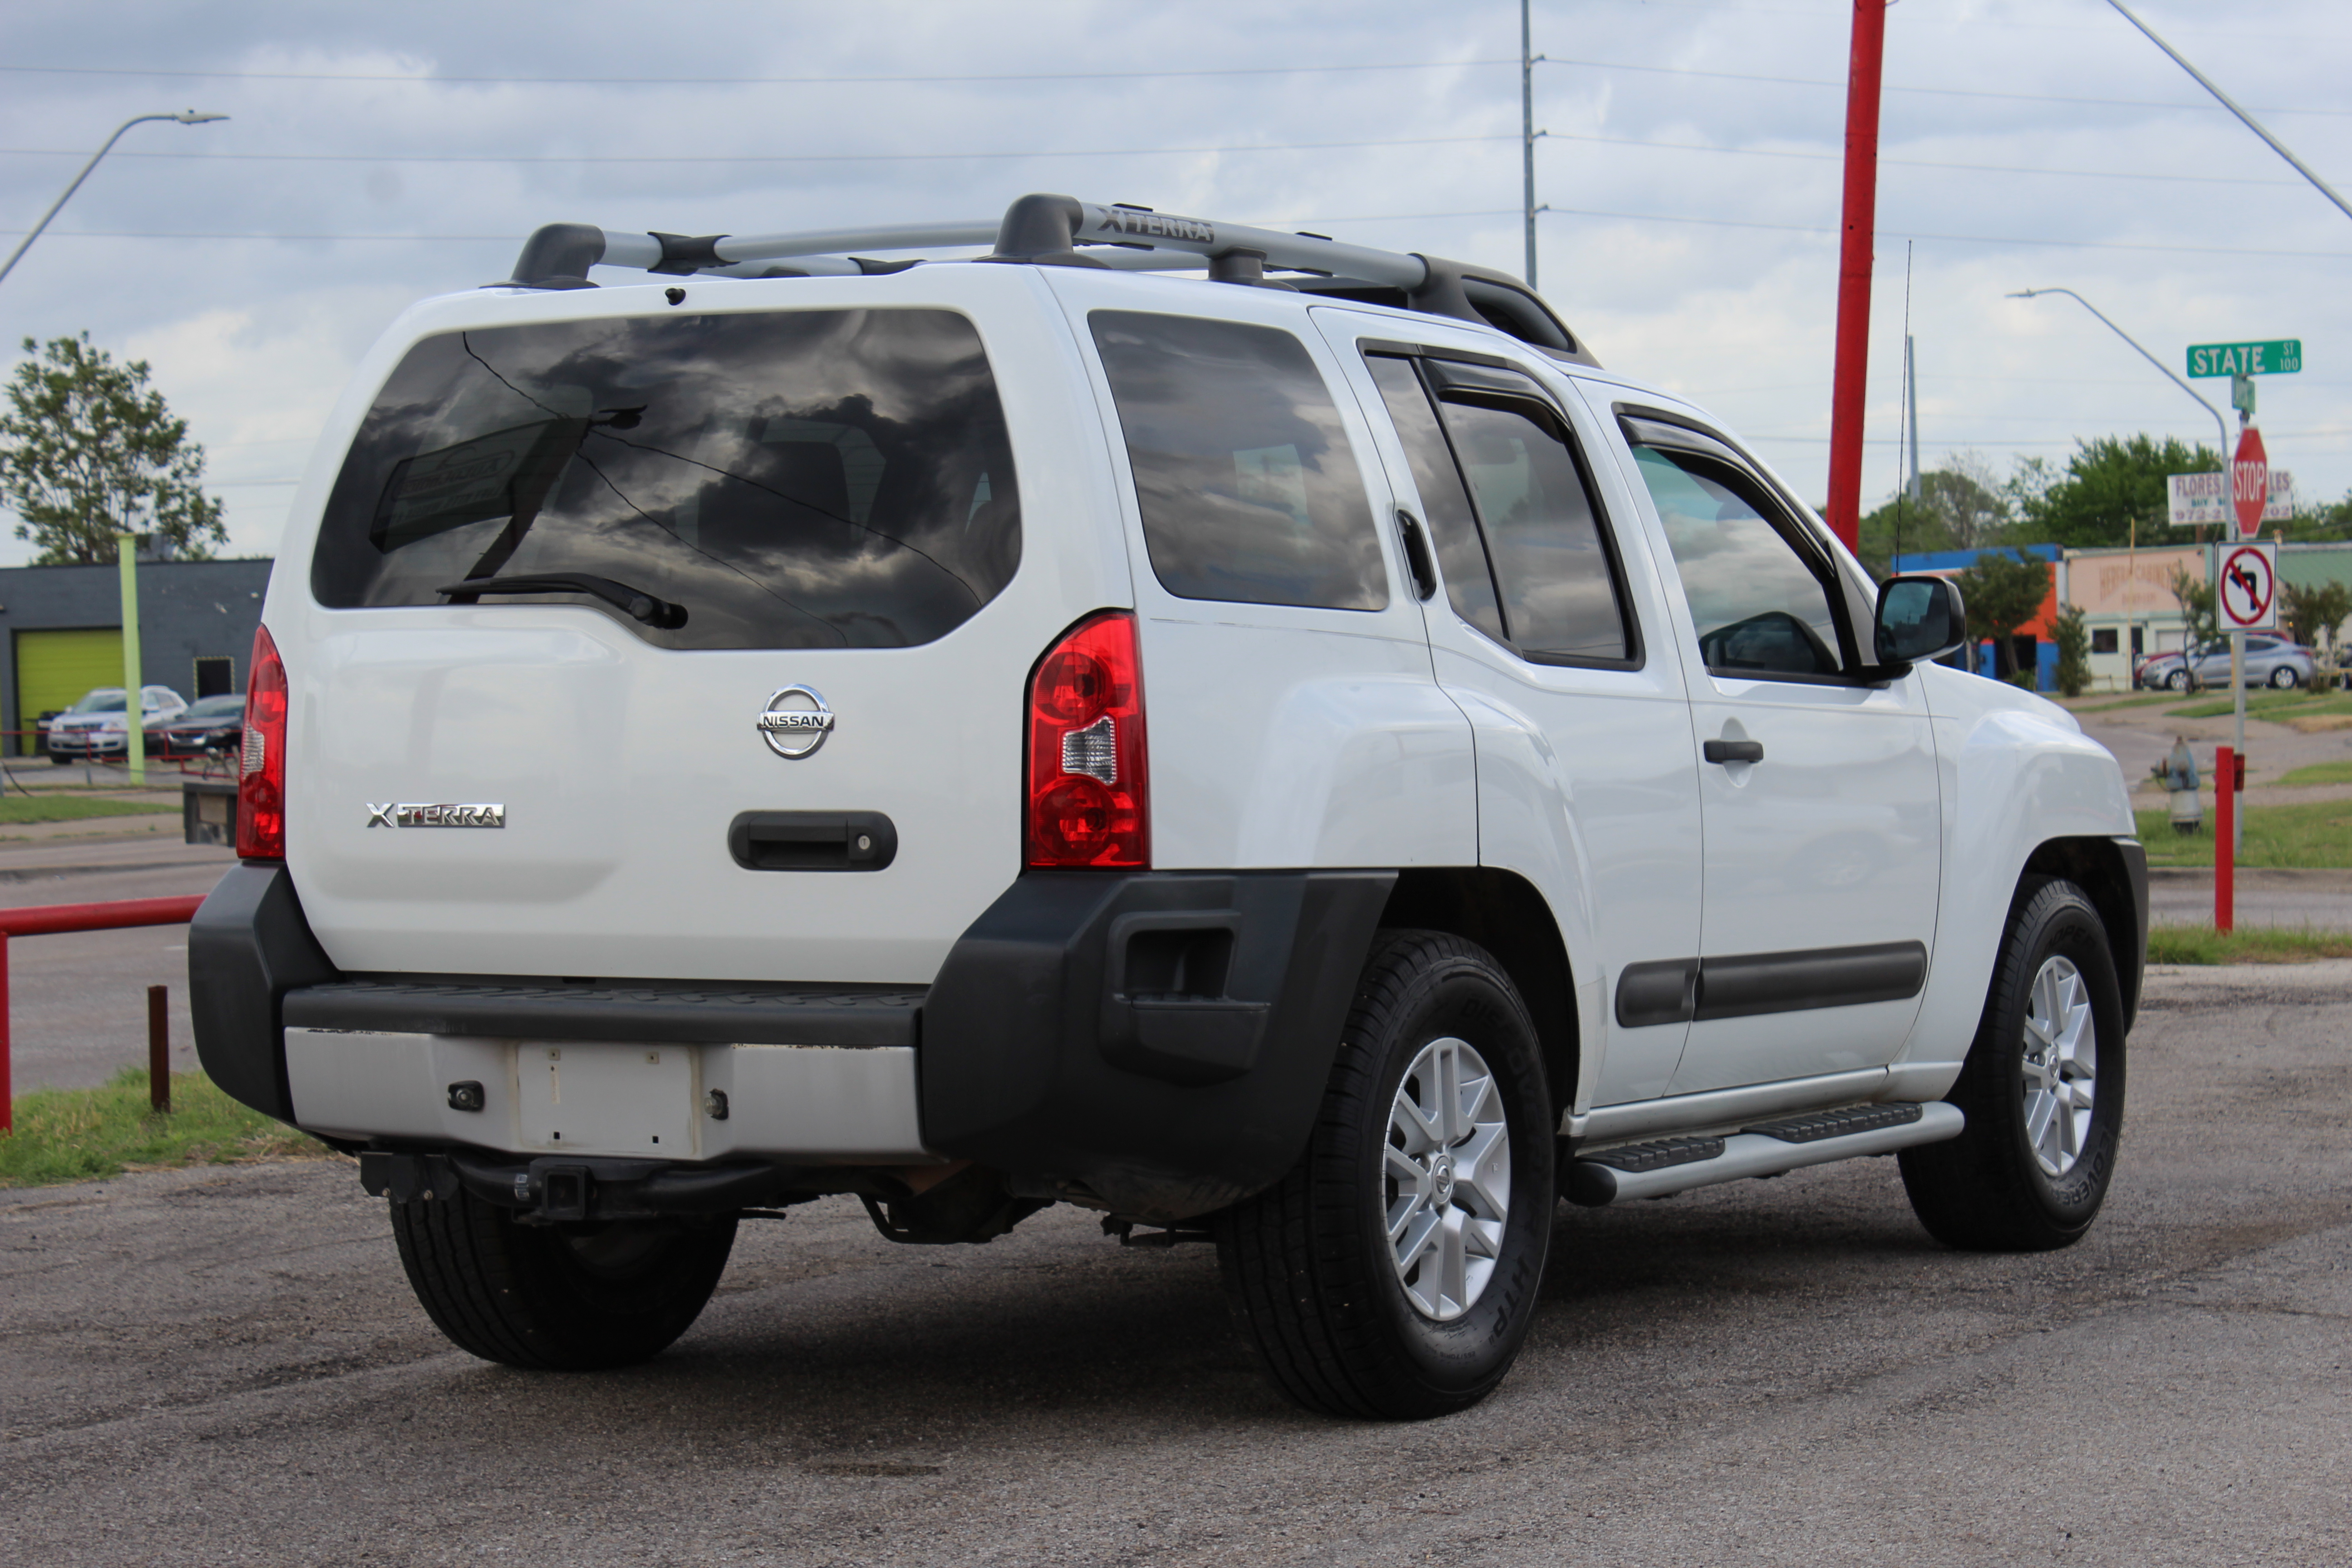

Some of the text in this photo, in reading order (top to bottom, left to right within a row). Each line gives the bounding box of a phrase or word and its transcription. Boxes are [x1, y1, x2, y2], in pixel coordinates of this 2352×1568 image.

[1096, 207, 1215, 245] XTERRA
[2194, 346, 2265, 374] STATE
[2283, 342, 2294, 355] ST
[2280, 357, 2298, 371] 100
[2175, 474, 2221, 497] FLORES
[2234, 461, 2265, 502] STOP
[763, 715, 824, 727] NISSAN
[365, 803, 505, 828] XTERRA
